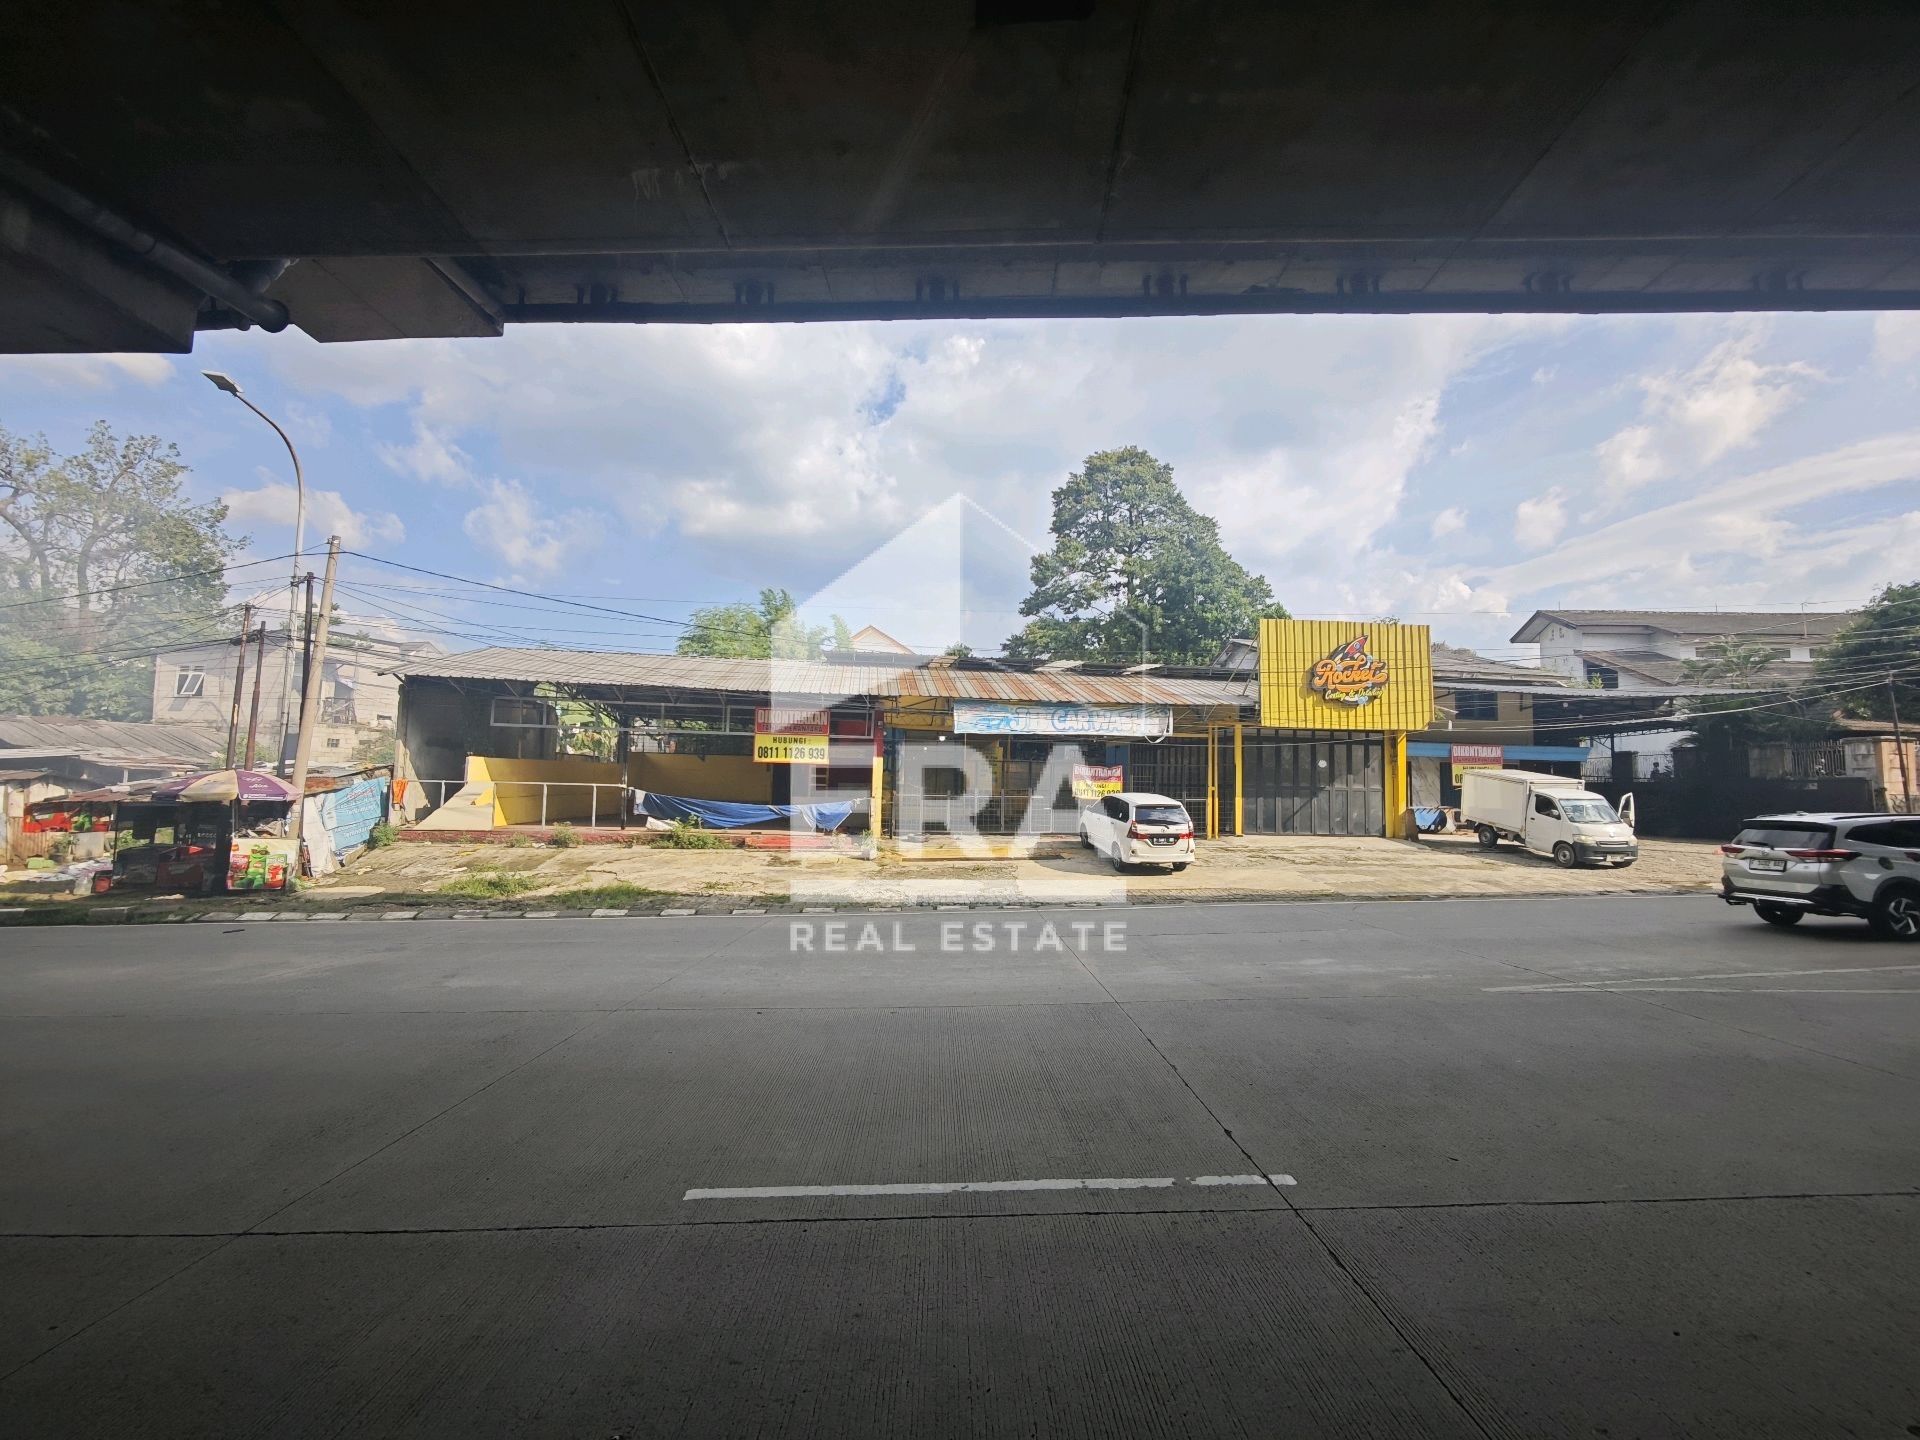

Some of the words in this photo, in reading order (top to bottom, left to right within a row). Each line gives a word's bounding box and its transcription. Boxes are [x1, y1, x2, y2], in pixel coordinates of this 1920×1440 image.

[1313, 655, 1389, 690] Rocket
[757, 709, 828, 725] DIKONTRAKAN
[1050, 708, 1090, 733] CAR
[772, 736, 807, 745] HUBUNGI
[757, 746, 779, 759] 0811
[783, 746, 805, 760] 1126
[808, 747, 825, 760] 939
[1453, 745, 1502, 758] DIKONTRAKAN
